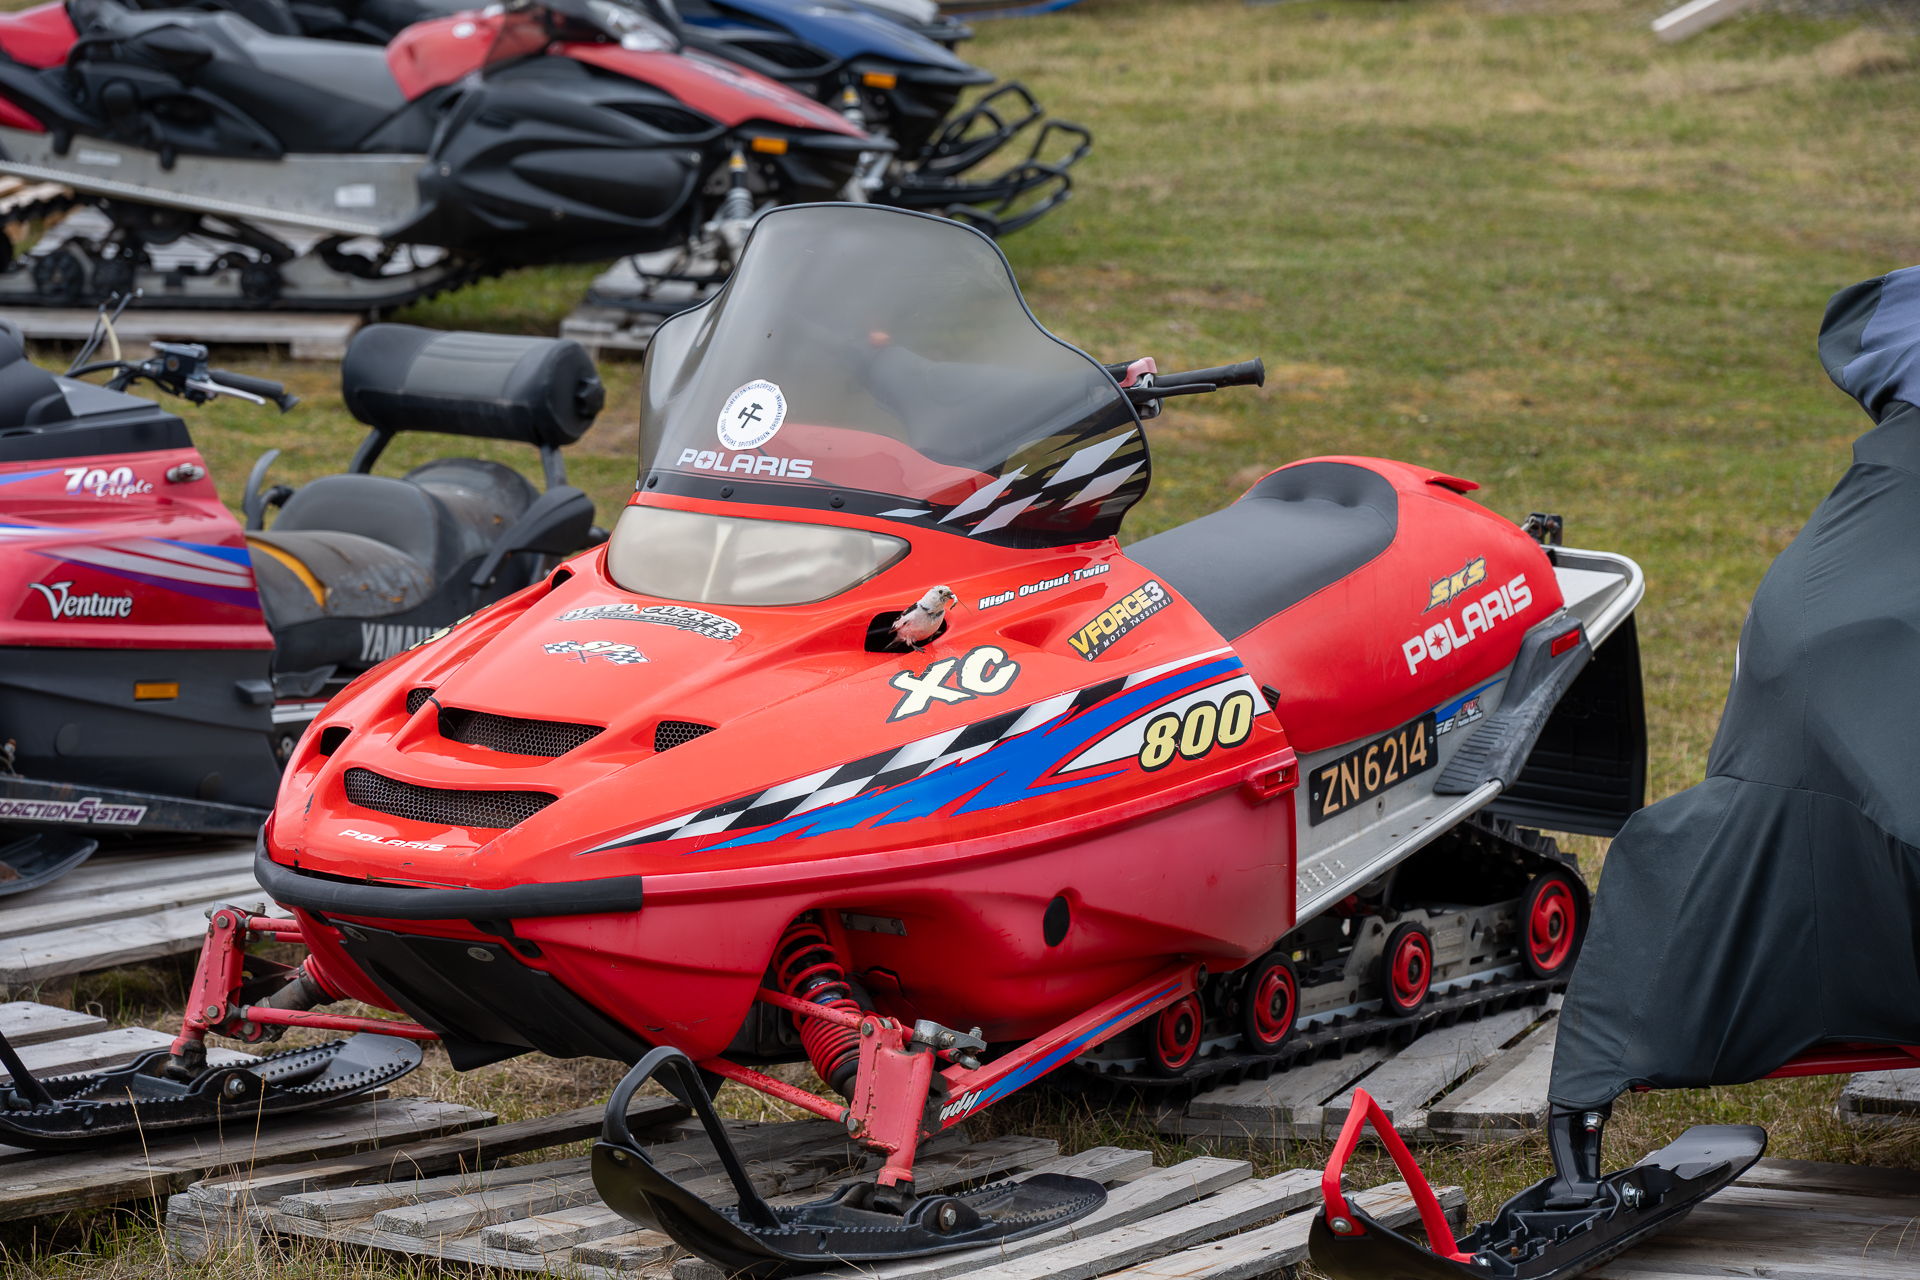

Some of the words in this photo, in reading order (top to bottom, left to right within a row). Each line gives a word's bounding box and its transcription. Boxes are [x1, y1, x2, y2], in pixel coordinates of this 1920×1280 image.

[737, 430, 771, 448] SPITSBERGEN
[64, 466, 135, 495] 700
[676, 447, 814, 479] POLARIS
[28, 580, 133, 621] Venture
[978, 590, 1015, 611] High
[1018, 573, 1070, 598] Output
[1073, 563, 1111, 581] Twin
[1426, 556, 1488, 610] SKS
[642, 605, 739, 637] CLICKER
[1068, 580, 1165, 655] VFORCE3
[1087, 649, 1100, 661] BY
[1102, 626, 1127, 648] MOTO
[1129, 597, 1172, 627] TASSINARI
[1401, 572, 1533, 677] POLARIS
[360, 622, 442, 661] YAMA
[886, 645, 1021, 723] XC
[1138, 690, 1255, 773] 800
[0, 801, 75, 819] OACTION
[338, 829, 447, 851] POLARIS
[939, 1088, 983, 1121] ndy
